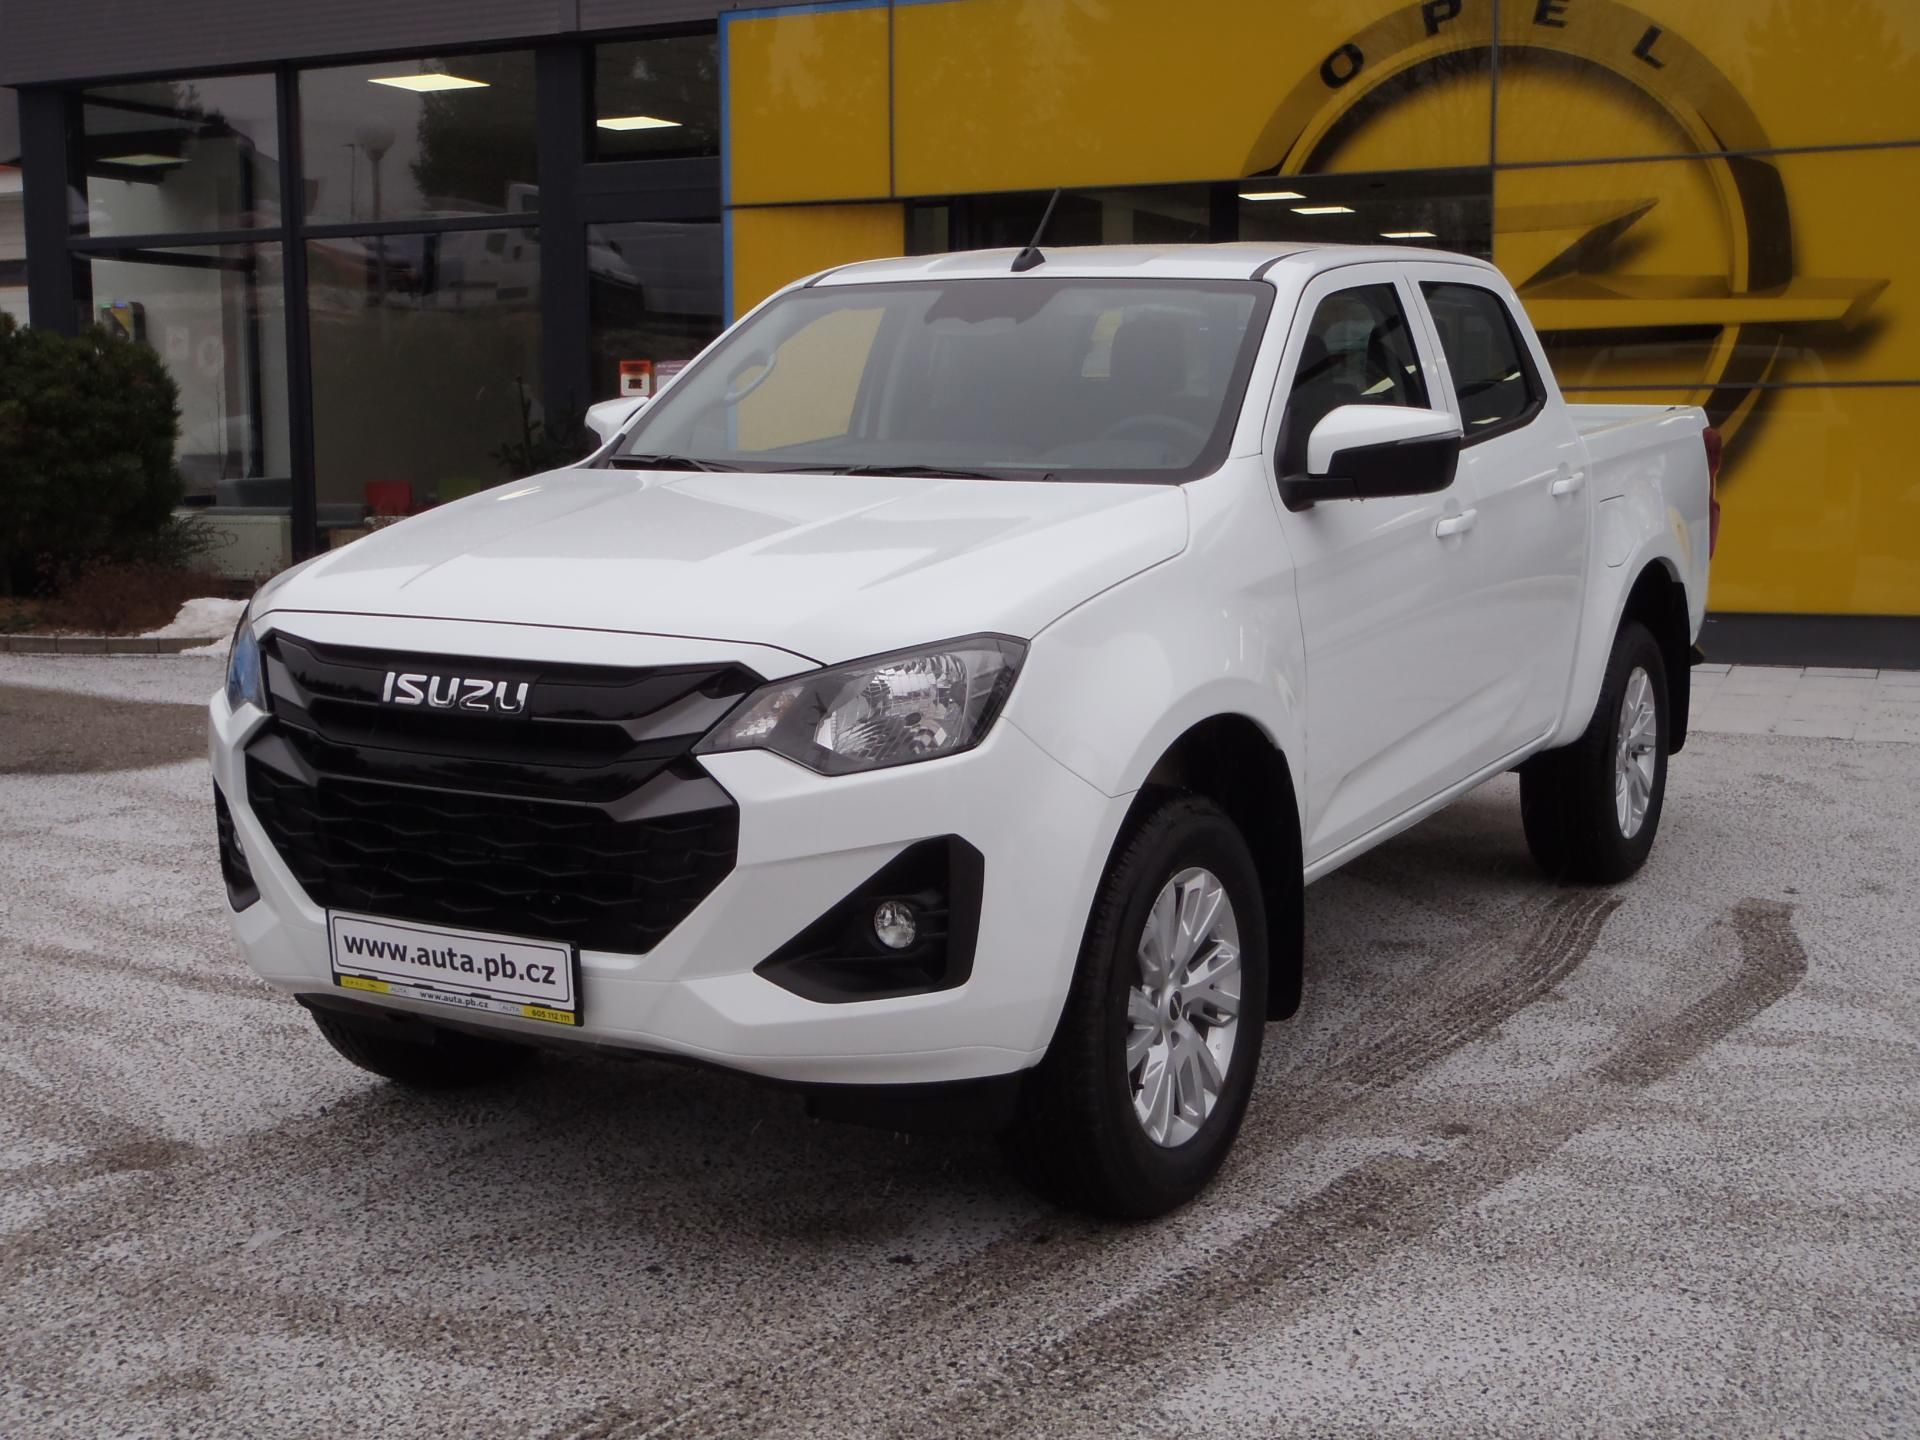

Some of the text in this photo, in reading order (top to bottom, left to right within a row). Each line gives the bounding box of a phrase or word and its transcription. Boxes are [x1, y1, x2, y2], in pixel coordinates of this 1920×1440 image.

[1319, 0, 1666, 89] OPEL
[382, 671, 529, 714] ISUZU
[343, 935, 557, 985] www.auta.pb.cz
[420, 991, 488, 1008] www.auta.pb.cz
